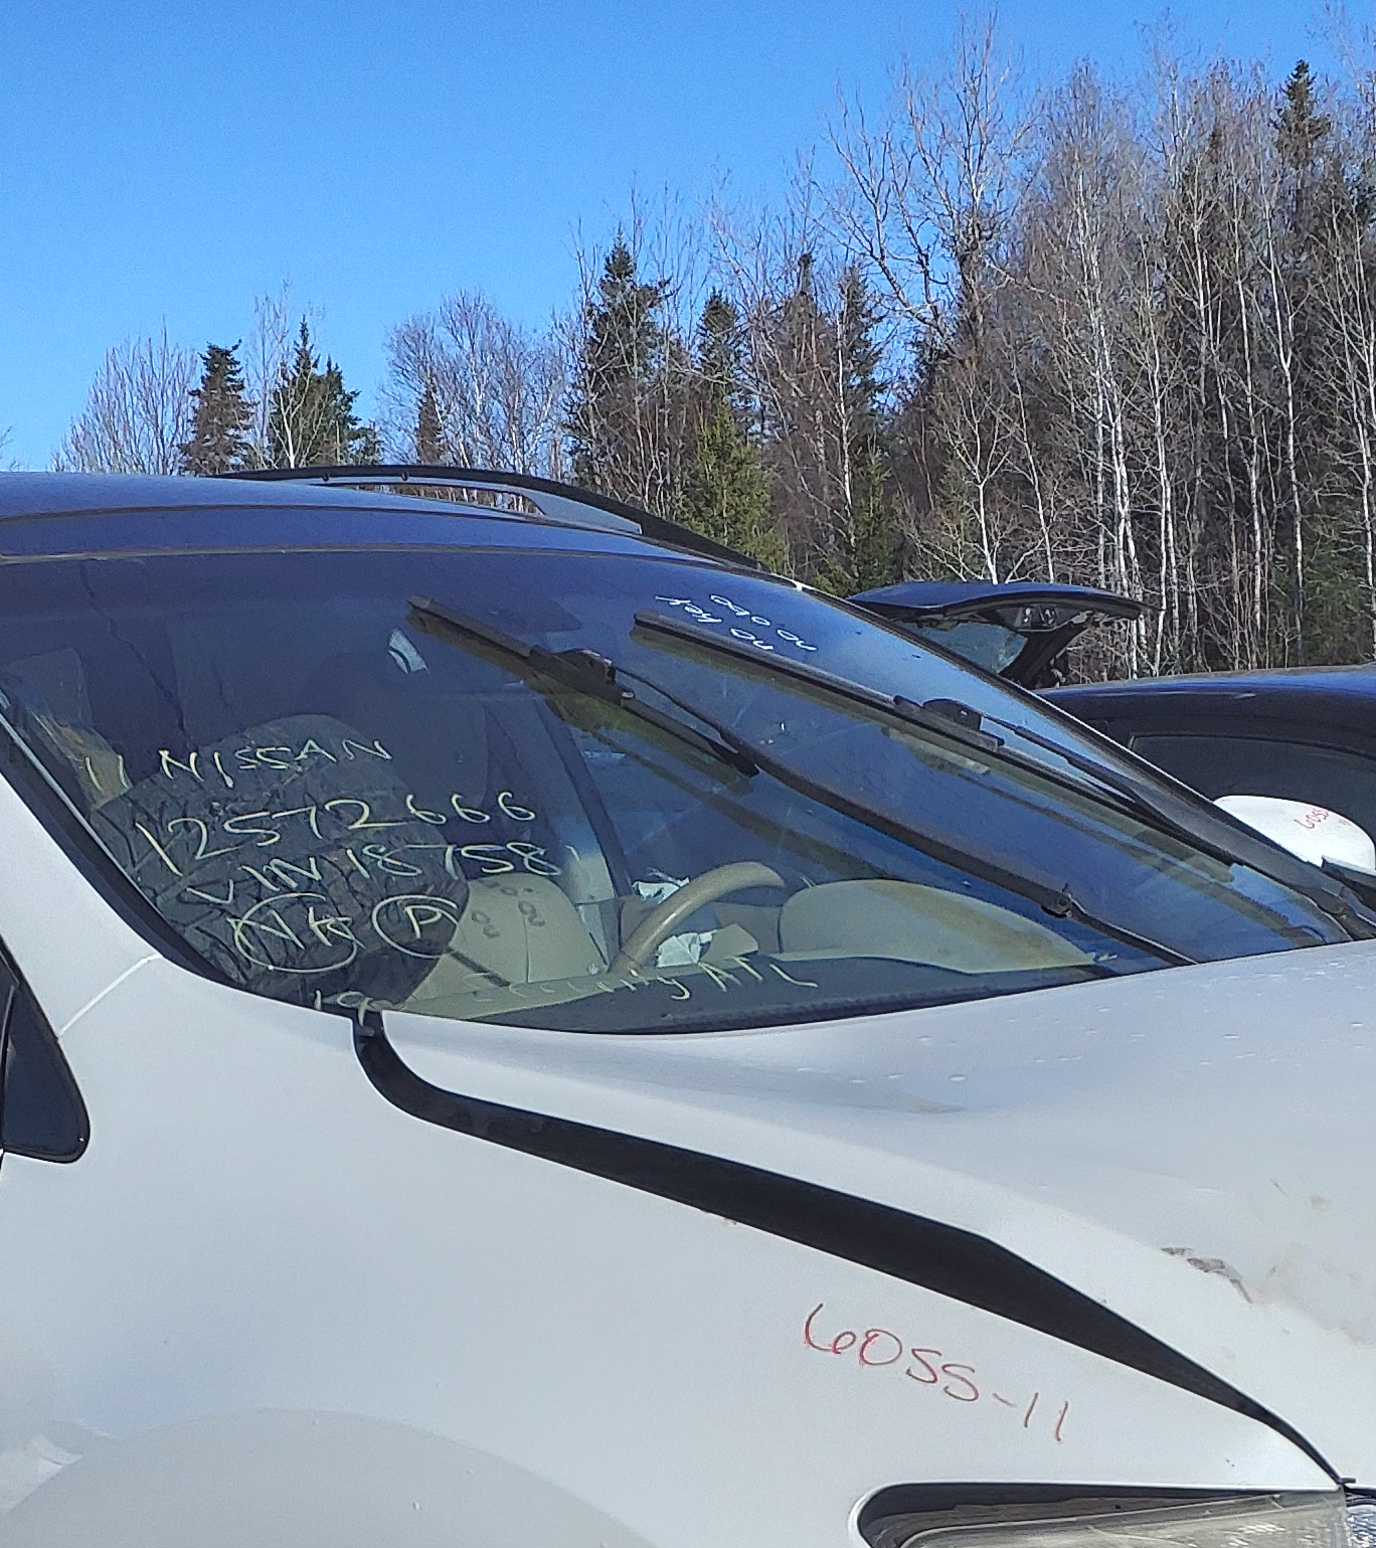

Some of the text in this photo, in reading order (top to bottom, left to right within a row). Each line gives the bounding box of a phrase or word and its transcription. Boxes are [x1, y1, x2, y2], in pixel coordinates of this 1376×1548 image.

[157, 738, 392, 789] NISSAN
[134, 791, 537, 878] 12572666
[186, 856, 323, 905] VIN
